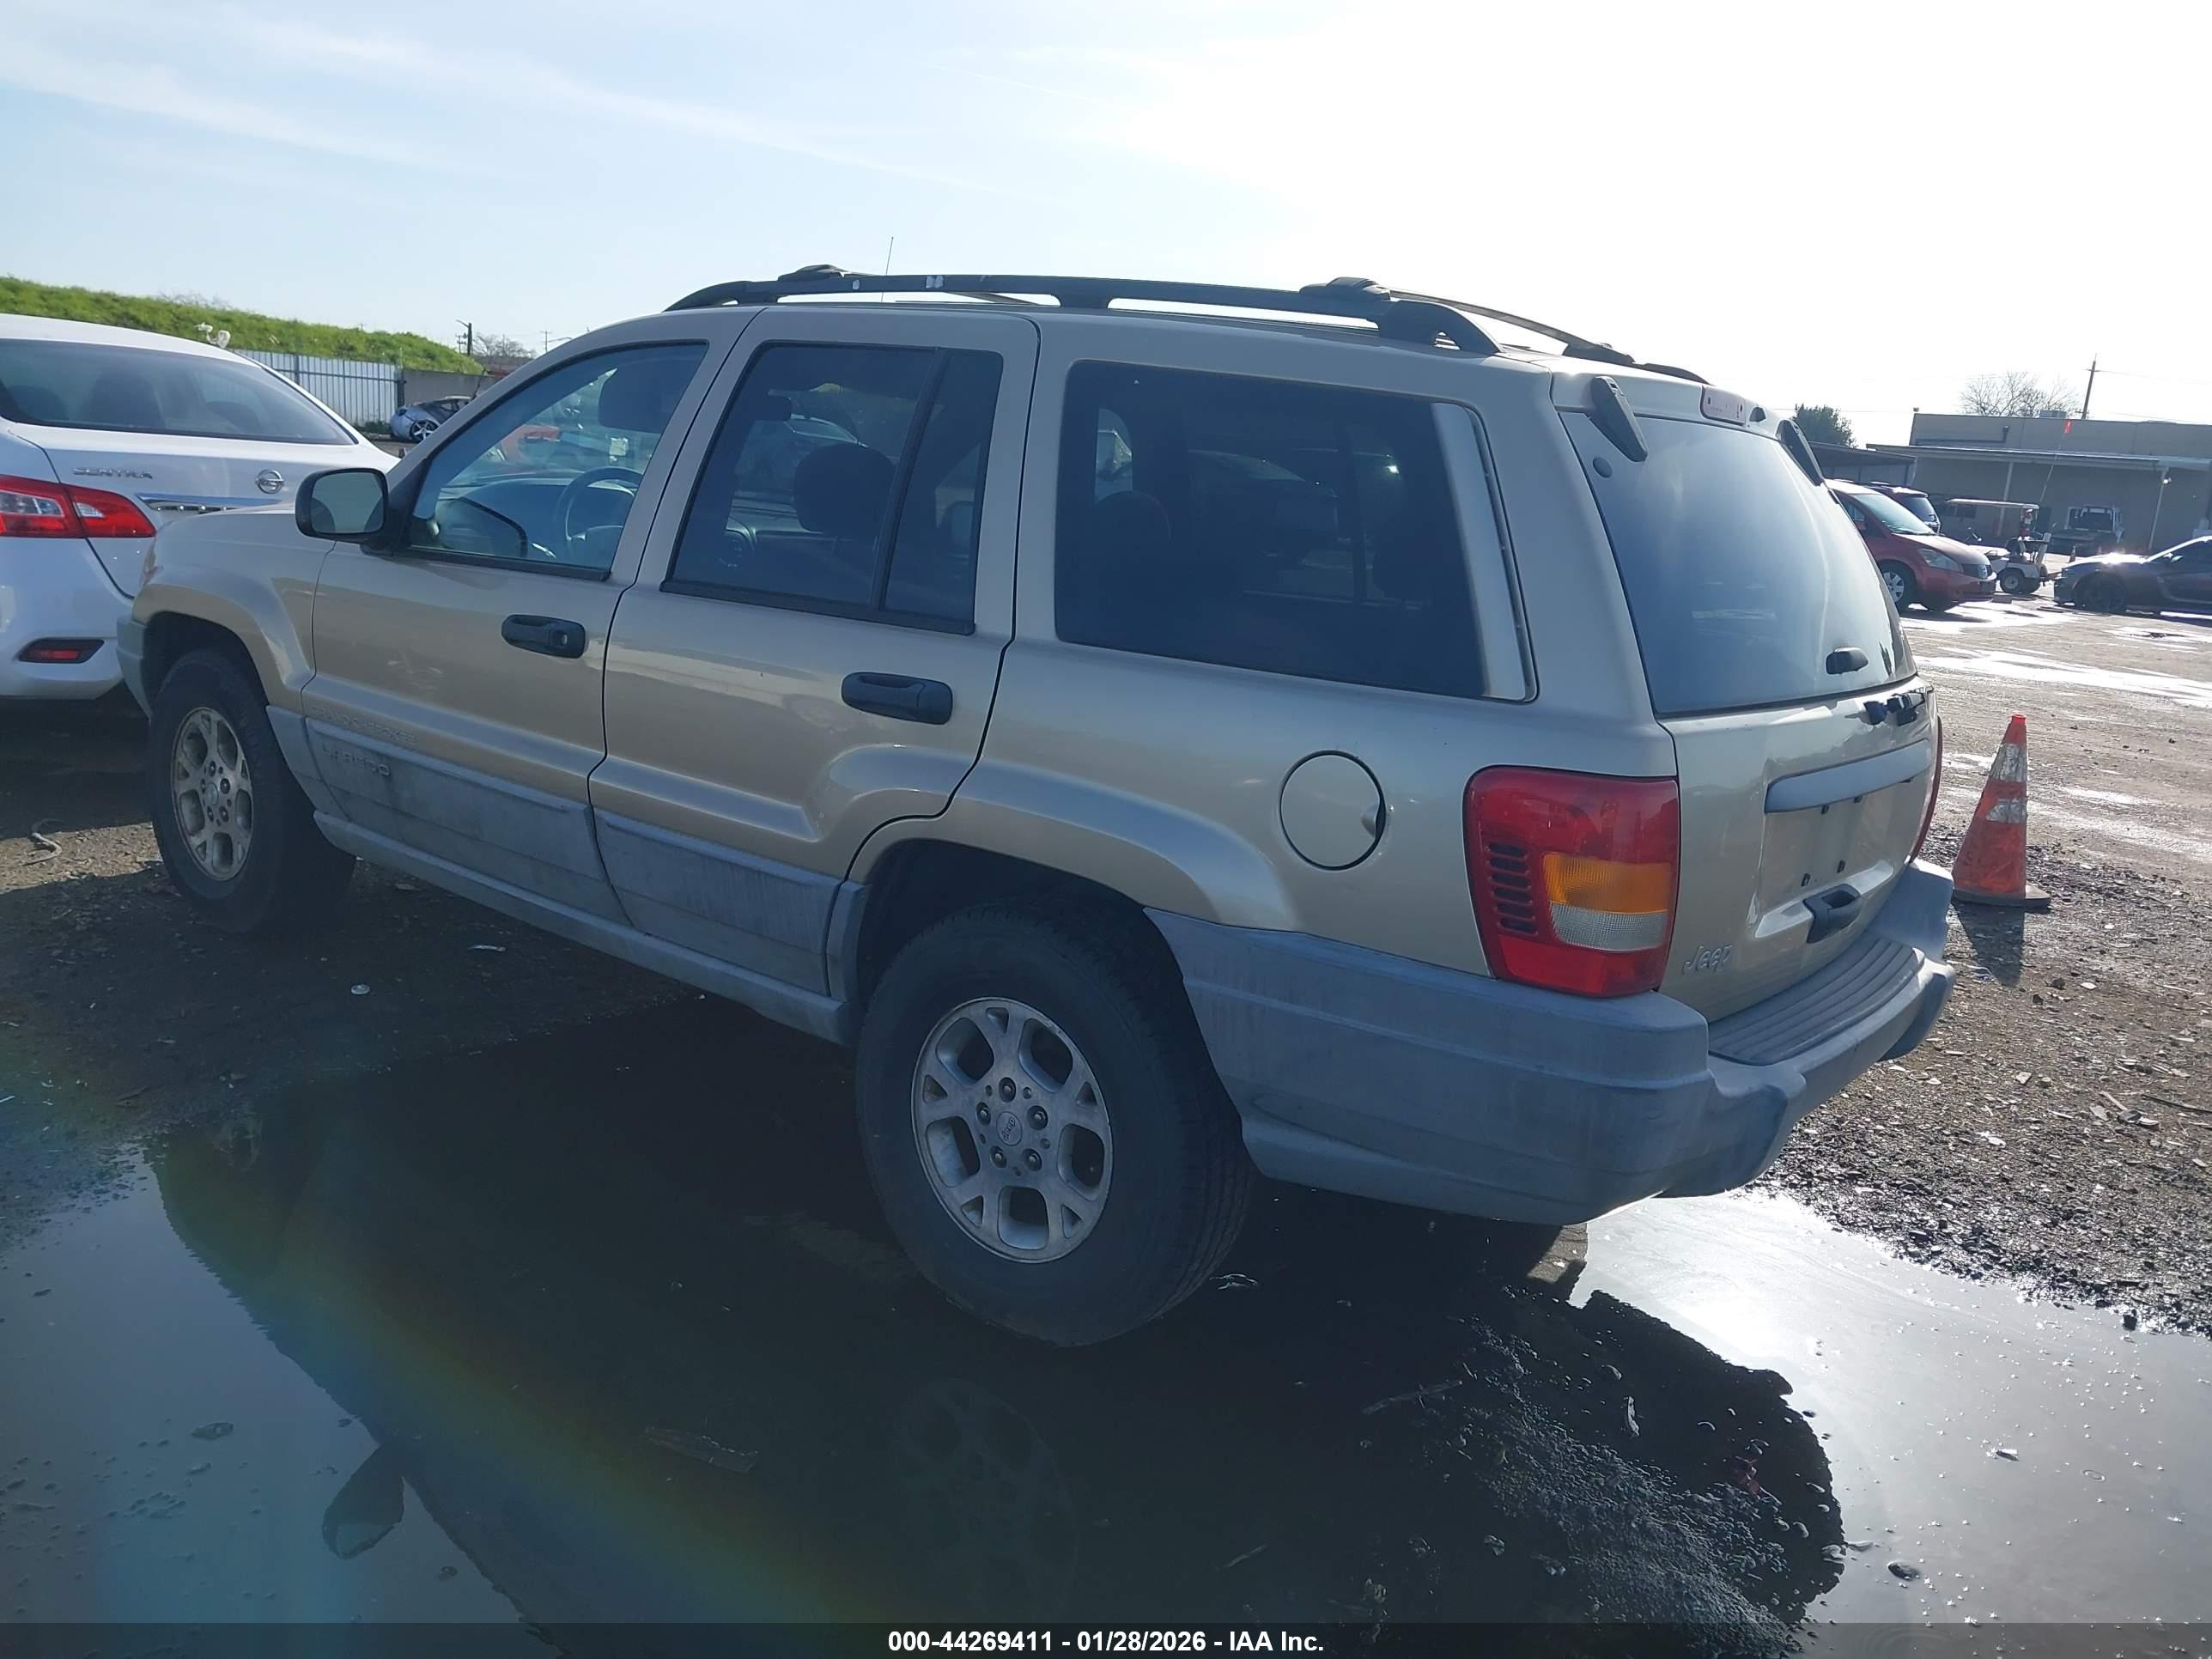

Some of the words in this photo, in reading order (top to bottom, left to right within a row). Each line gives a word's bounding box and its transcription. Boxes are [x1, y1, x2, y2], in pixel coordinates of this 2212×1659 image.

[73, 468, 153, 479] SENTRA
[322, 743, 391, 776] LAREDO
[1683, 945, 1732, 973] Jeep
